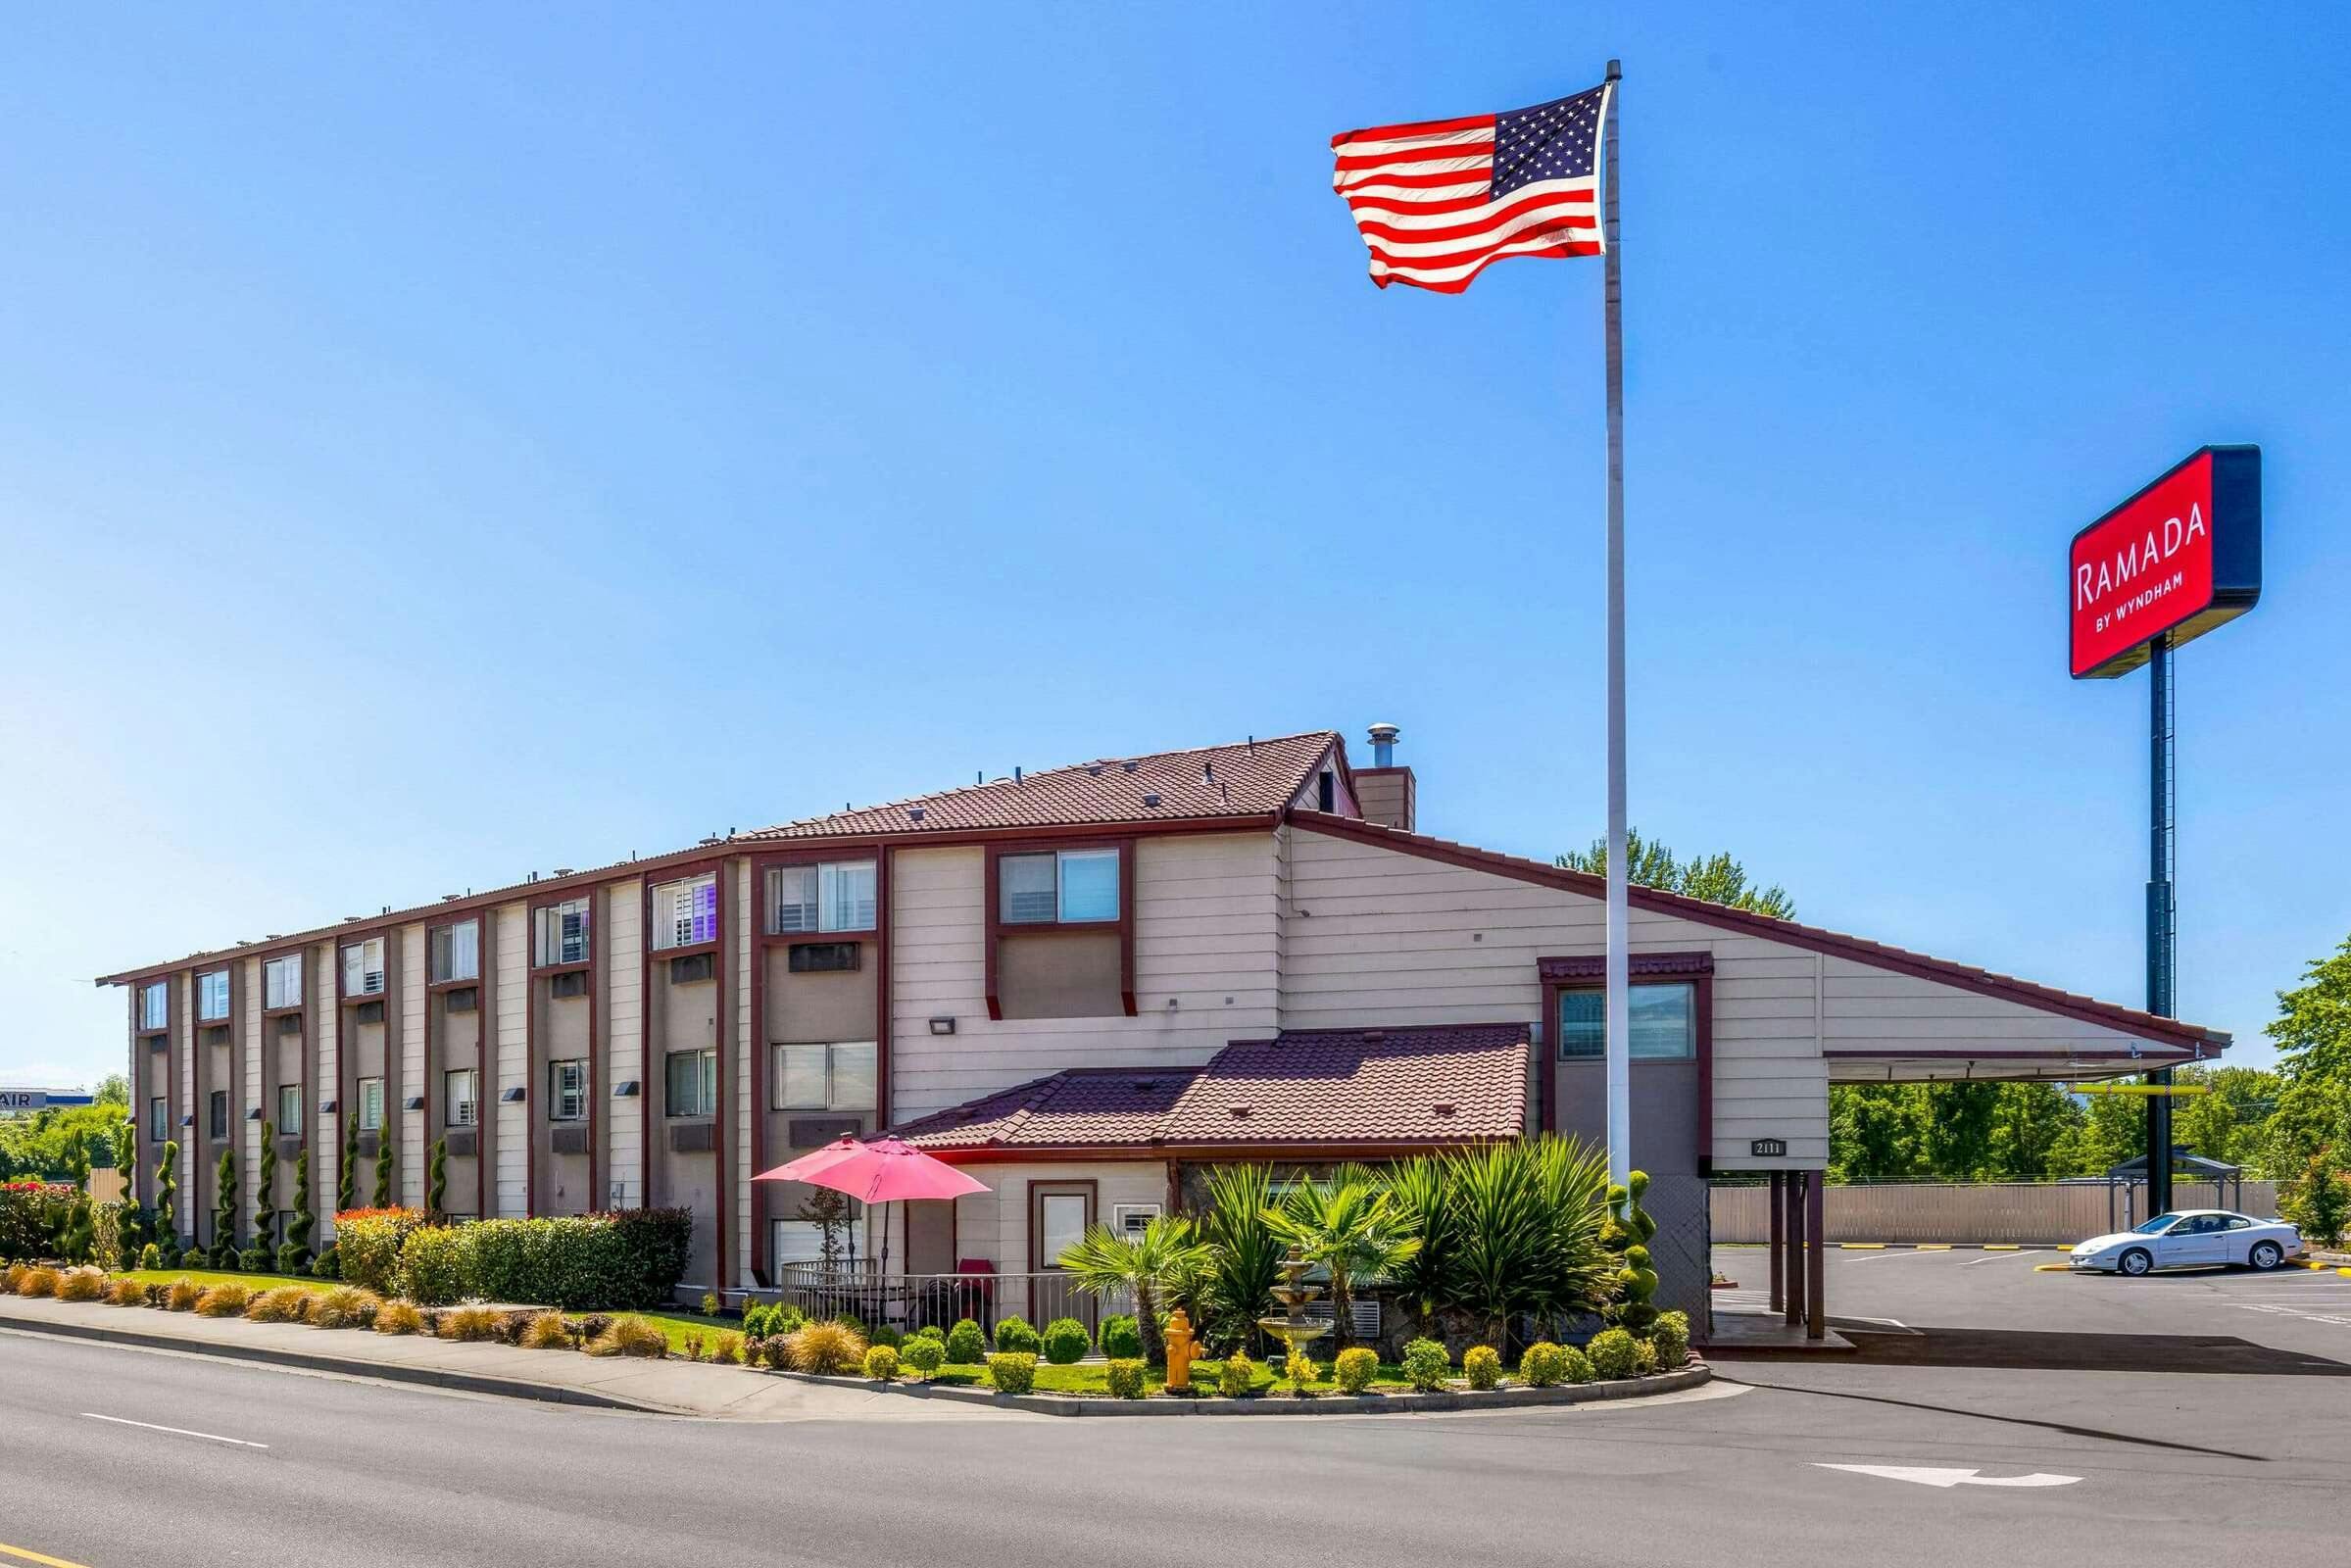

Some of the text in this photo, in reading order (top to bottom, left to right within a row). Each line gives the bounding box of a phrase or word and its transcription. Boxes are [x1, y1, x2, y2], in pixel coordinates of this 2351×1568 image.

[2077, 502, 2206, 612] RAMADA
[2095, 571, 2182, 633] BY WYNDHAM
[1756, 1143, 1780, 1153] 2111
